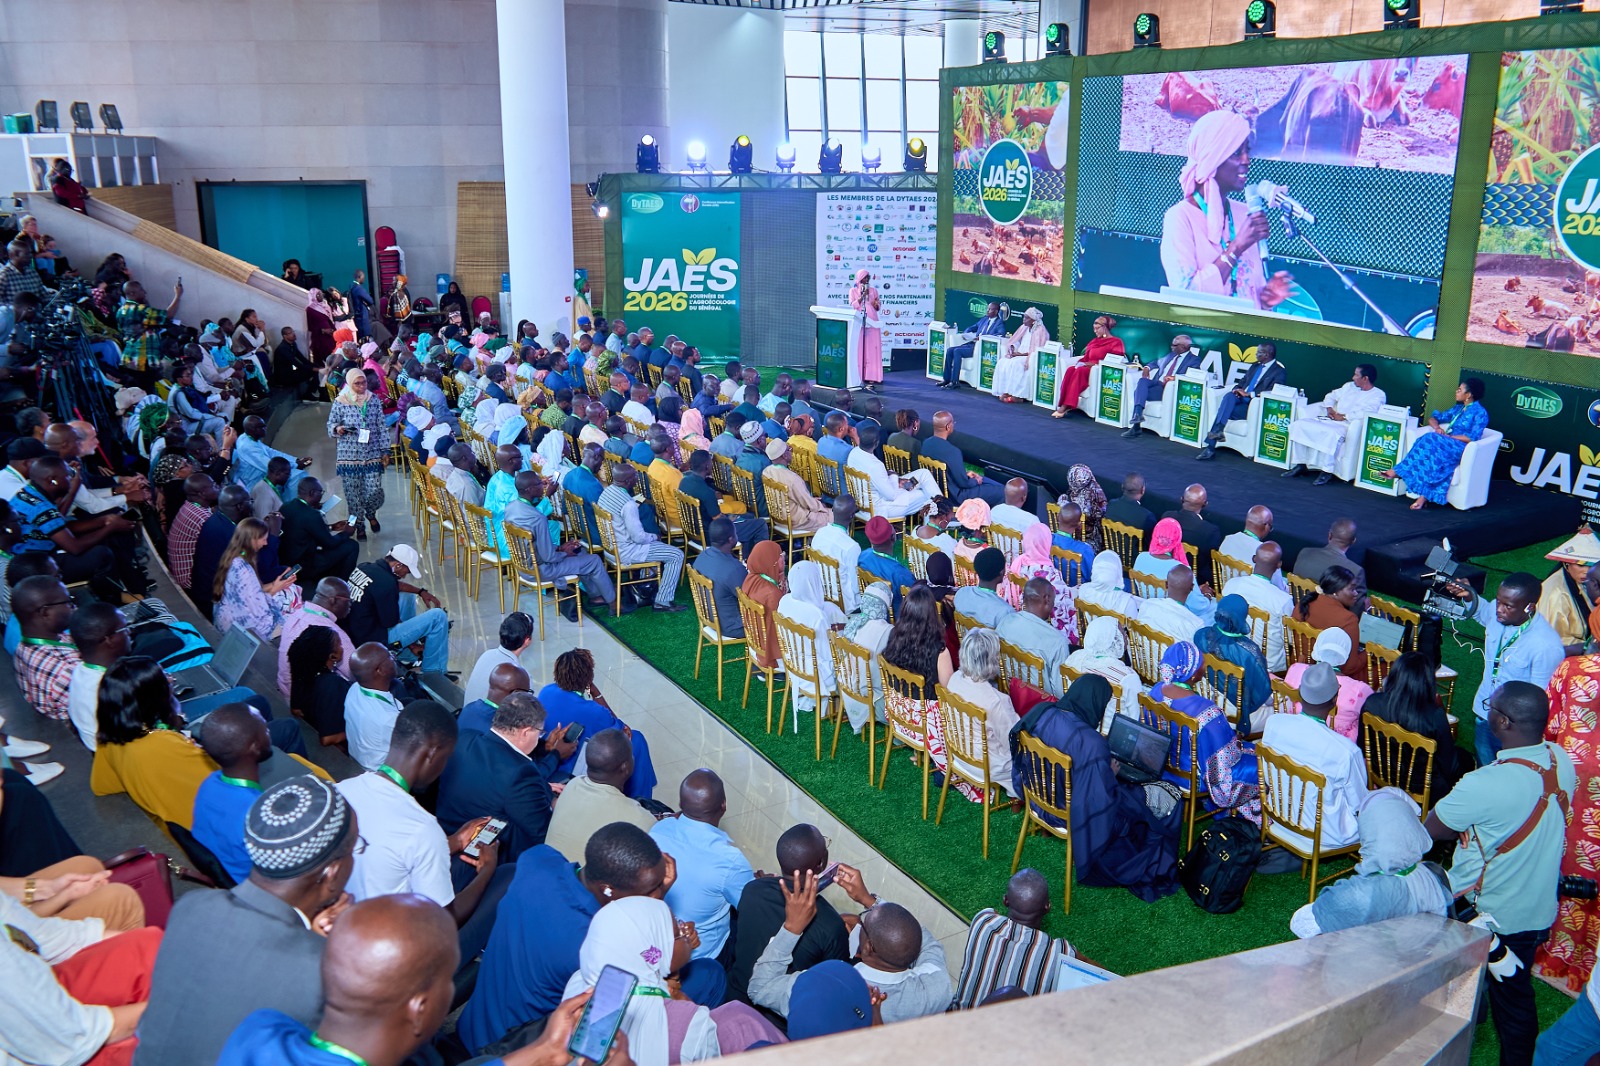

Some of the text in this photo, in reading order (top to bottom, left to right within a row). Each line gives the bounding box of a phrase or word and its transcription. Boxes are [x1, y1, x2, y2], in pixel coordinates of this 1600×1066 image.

[983, 165, 1028, 189] JAES
[983, 188, 1007, 201] 2026
[624, 258, 738, 291] JAES
[624, 292, 688, 311] 2026
[819, 345, 845, 358] JAES
[1179, 395, 1201, 408] JAES
[1516, 393, 1557, 412] DyTAES
[1264, 414, 1290, 428] JAES
[1368, 435, 1399, 451] JAES
[1510, 447, 1600, 500] JAE
